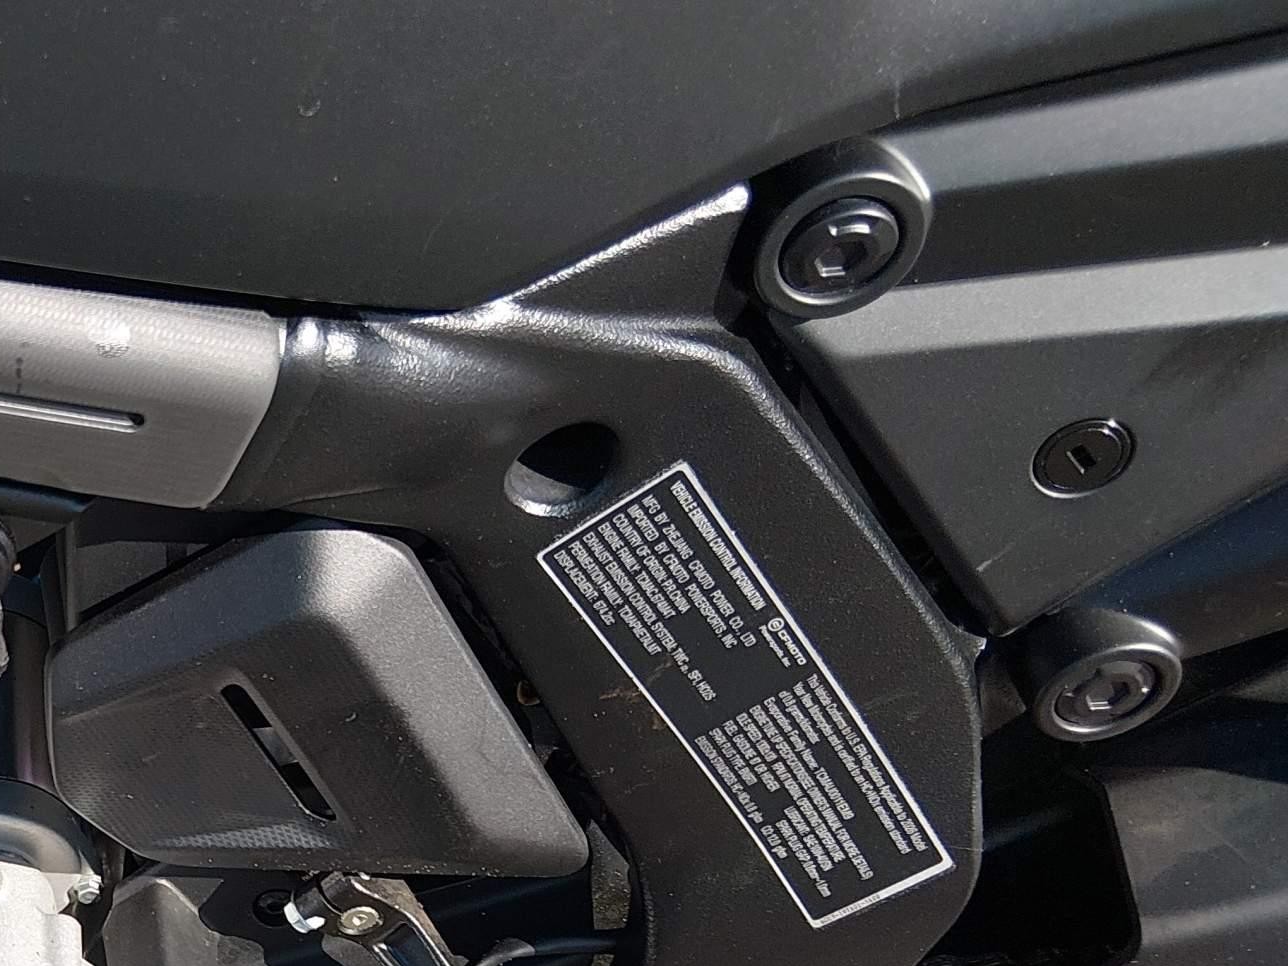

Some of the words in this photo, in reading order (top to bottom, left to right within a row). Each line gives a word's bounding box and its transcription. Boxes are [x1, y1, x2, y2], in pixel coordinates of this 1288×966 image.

[640, 493, 662, 515] MFG
[610, 511, 644, 550] COUNTRY
[625, 502, 660, 543] IMPORTED
[653, 510, 671, 527] BY
[596, 521, 625, 552] ENGINE
[614, 545, 643, 576] FAMILY:
[634, 543, 652, 559] OF
[653, 540, 670, 556] BY
[661, 522, 694, 561] ZHEJIANG
[668, 479, 698, 512] VEHICLE
[687, 506, 718, 542] EMISSION
[708, 536, 739, 571] CONTROL
[728, 565, 767, 611] INFORMATION
[552, 548, 600, 604] DISPLACEMENT:
[566, 539, 608, 587] PERMEATION
[597, 579, 626, 610] FAMILY:
[581, 530, 614, 566] EXHAUST
[604, 560, 637, 597] EMISSION
[626, 590, 658, 626] CONTROL
[642, 553, 670, 584] ORIGIN:
[661, 551, 691, 584] CFMOTO
[686, 557, 716, 591] CFMOTO
[708, 588, 735, 618] POWER
[719, 632, 738, 650] INC
[738, 630, 758, 649] LTD
[776, 628, 808, 667] CFMOTO
[790, 680, 809, 697] Year
[804, 672, 822, 689] This
[798, 692, 817, 709] New
[812, 683, 834, 707] Vehicle
[760, 695, 795, 735] Evaporative
[783, 729, 808, 753] Family
[824, 701, 850, 730] Conforms
[826, 732, 843, 747] and
[840, 725, 853, 736] to
[832, 741, 846, 752] is
[836, 747, 860, 771] certified
[851, 742, 869, 758] EPA
[752, 762, 768, 775] OR
[849, 767, 863, 777] to
[853, 773, 866, 784] an
[856, 753, 888, 788] Regulations
[875, 783, 906, 816] Applicable
[819, 806, 844, 832] MANUAL
[872, 803, 899, 832] emission
[895, 811, 909, 821] to
[773, 818, 795, 839] SPARK
[784, 834, 804, 852] PLUG
[794, 795, 823, 827] OPERATING
[810, 822, 848, 863] TEMPERATURE
[833, 827, 851, 843] FOR
[887, 827, 913, 855] standard
[907, 831, 929, 852] Model
[839, 838, 861, 858] MORE
